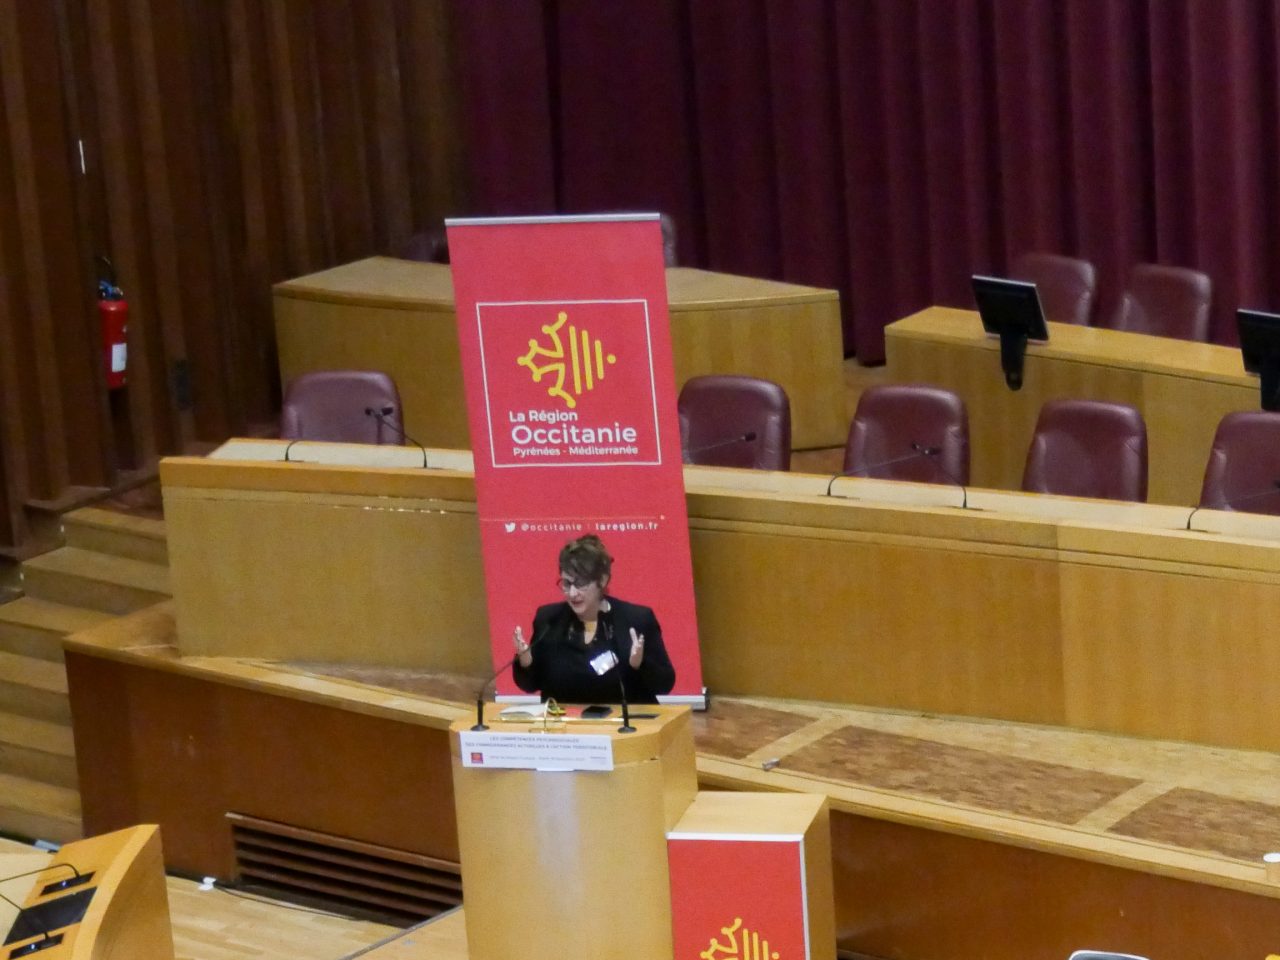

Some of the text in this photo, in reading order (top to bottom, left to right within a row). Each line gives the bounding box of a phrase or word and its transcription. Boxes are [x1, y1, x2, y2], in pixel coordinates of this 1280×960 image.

[509, 409, 578, 424] La Région
[512, 422, 637, 444] Occitanie
[513, 447, 561, 458] Pyrénées
[569, 445, 638, 456] Méditerranée
[521, 522, 659, 532] @occitanie laregion.fr
